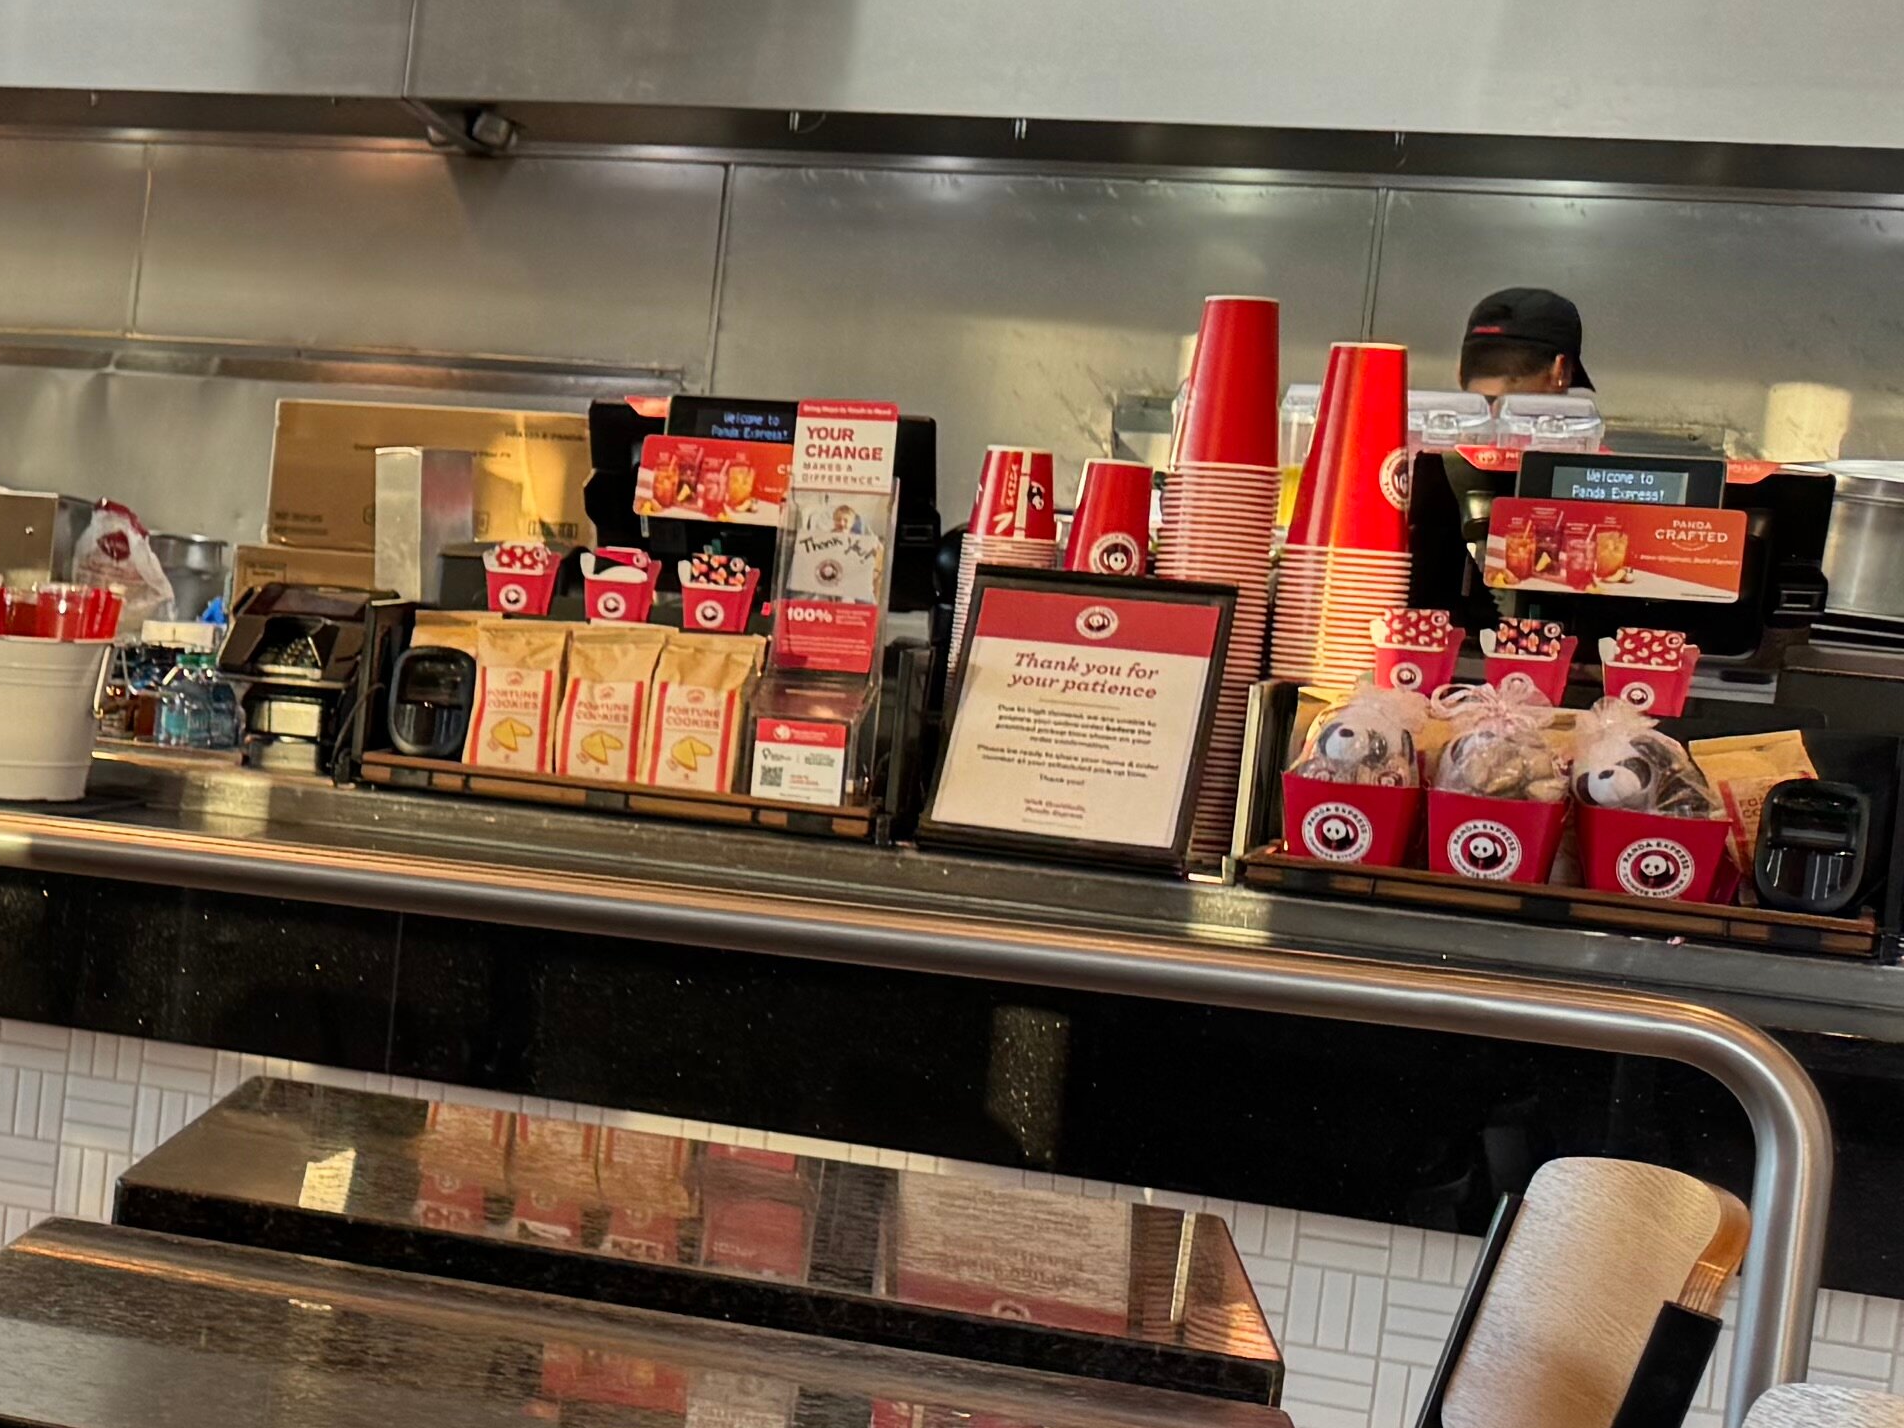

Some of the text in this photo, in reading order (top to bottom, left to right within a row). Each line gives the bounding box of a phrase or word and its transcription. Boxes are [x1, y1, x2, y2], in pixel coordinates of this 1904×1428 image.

[806, 426, 854, 442] YOUR
[805, 444, 883, 461] CHANGE
[1587, 470, 1654, 485] Welcome to
[1572, 485, 1605, 499] Panda
[1673, 519, 1712, 530] PANDA
[1655, 529, 1728, 543] CRAFTED
[788, 606, 832, 623] 100%
[1015, 652, 1159, 680] Thank you for
[1007, 673, 1157, 699] your patience
